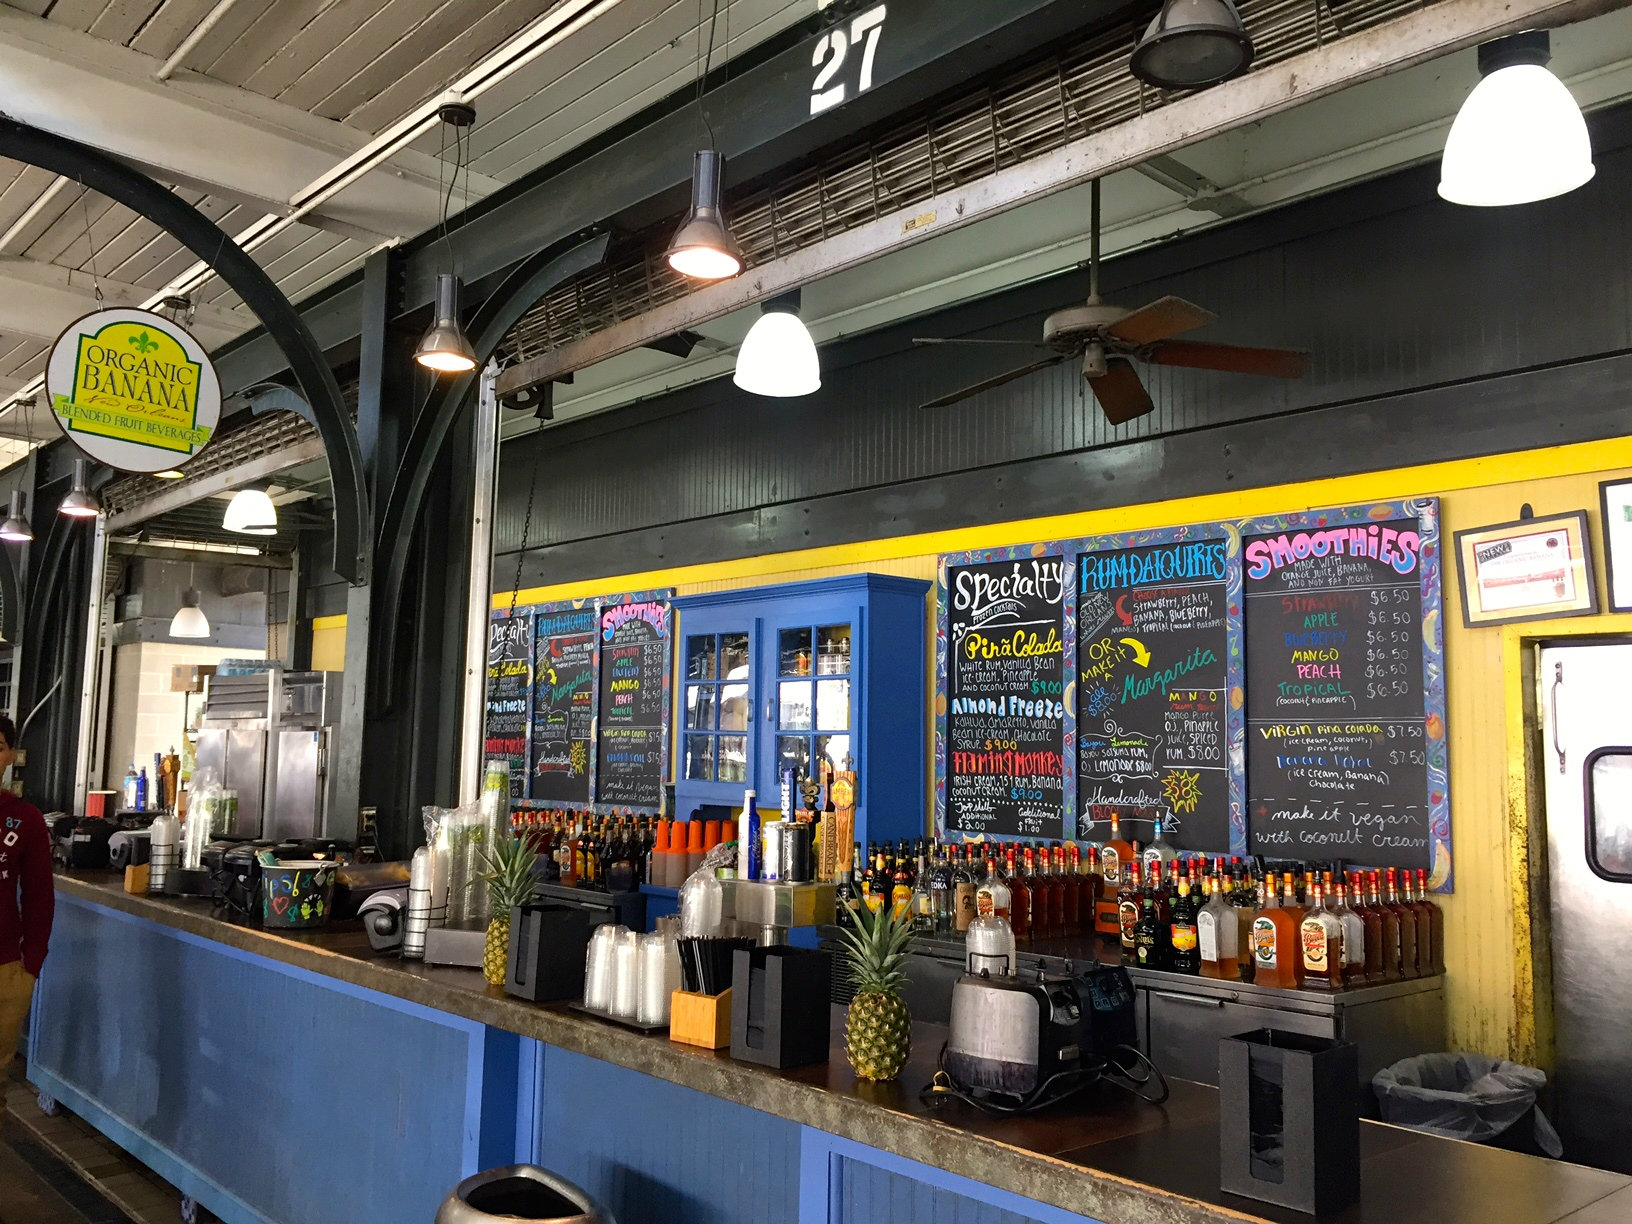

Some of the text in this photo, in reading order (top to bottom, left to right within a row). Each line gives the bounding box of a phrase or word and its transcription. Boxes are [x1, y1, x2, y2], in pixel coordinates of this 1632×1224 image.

[810, 4, 886, 115] 27
[87, 345, 193, 386] ORGANIC
[82, 364, 190, 412] BANANA
[62, 404, 201, 443] BLENDED FRUIT BEVERAGES
[1080, 543, 1226, 594] RUM DAIQUIRIS
[1294, 555, 1342, 572] MADE WITH
[1282, 563, 1372, 582] ORANGE JUICE, BANANA,
[954, 560, 1063, 610] Specialty
[1288, 578, 1306, 588] AND
[1308, 577, 1324, 586] NON
[1182, 592, 1213, 606] PEACH,
[1370, 589, 1410, 606] $6.50
[1133, 610, 1168, 626] BANANA,
[1304, 610, 1410, 628] APPLE $6.50
[1013, 628, 1063, 657] Colada
[1366, 630, 1409, 645] $6.50
[1090, 638, 1116, 660] OR
[1291, 648, 1408, 664] MANGO $6.50
[1082, 656, 1114, 682] MAKE
[1104, 672, 1114, 682] A
[1121, 646, 1218, 705] Margarita
[1296, 663, 1408, 679] PEACH $6.50
[610, 679, 640, 692] MANGO
[1031, 681, 1062, 695] $9.00
[1366, 681, 1408, 699] $6.50
[1169, 691, 1216, 702] MANGO
[951, 696, 1063, 719] Almond Freeze
[1387, 726, 1422, 738] $7.50
[984, 739, 1018, 751] $9.00
[1188, 745, 1220, 760] $8.00
[1014, 751, 1063, 776] Monkey
[1389, 751, 1425, 765] $7.50
[1288, 768, 1304, 781] (ice
[1170, 778, 1192, 800] $8
[1309, 779, 1356, 790] chocolate
[1011, 787, 1043, 800] $9.00
[1086, 786, 1164, 808] Handcrafted
[6, 816, 22, 830] 87
[958, 819, 986, 830] $2.00
[1272, 805, 1422, 832] make it vegan
[1018, 822, 1040, 833] $1.00
[828, 815, 836, 869] CANEBRAKE
[1256, 828, 1428, 848] with coconut cream
